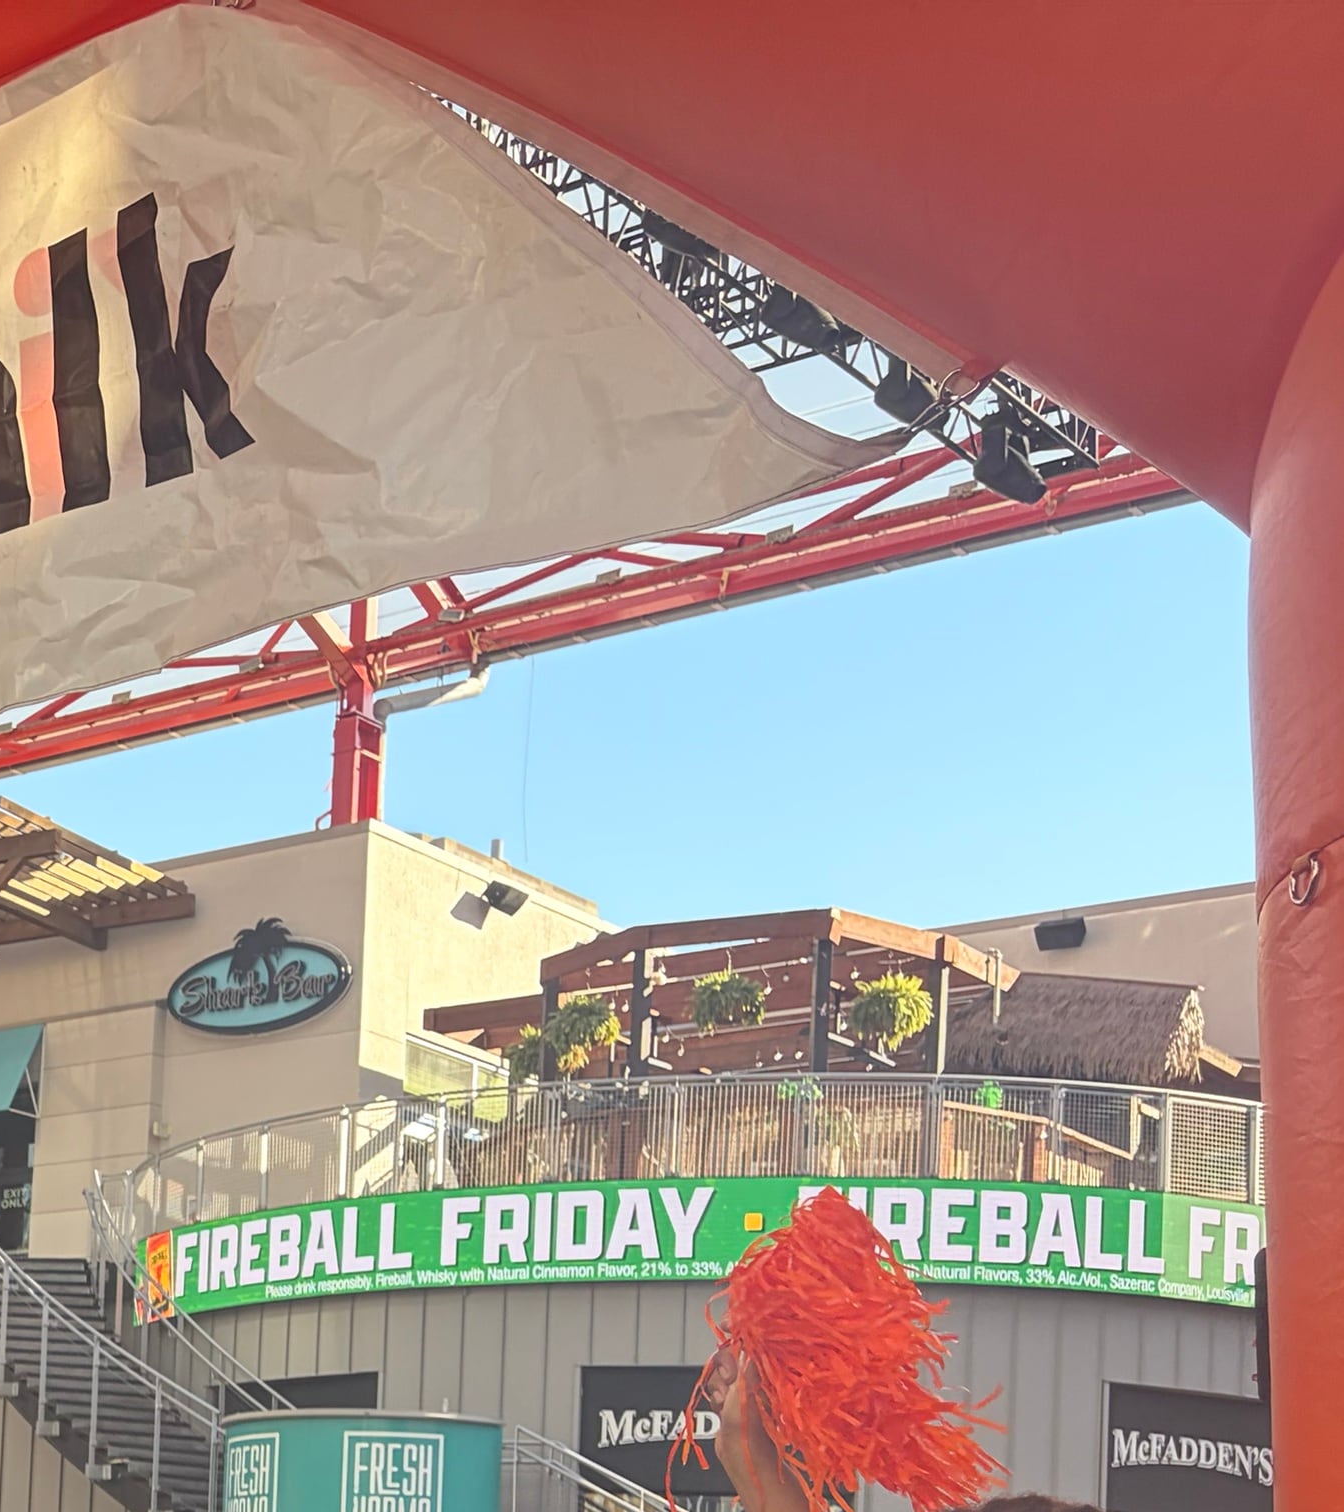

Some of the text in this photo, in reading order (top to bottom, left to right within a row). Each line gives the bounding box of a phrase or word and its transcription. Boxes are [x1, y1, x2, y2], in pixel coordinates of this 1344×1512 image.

[179, 959, 336, 1017] Shark Bar
[174, 1203, 413, 1298] FIREBALL
[440, 1187, 715, 1266] FRIDAY
[798, 1185, 1165, 1275] REBALL
[265, 1282, 293, 1299] Please
[294, 1279, 317, 1296] drink
[417, 1268, 456, 1285] Whisky
[460, 1267, 485, 1281] with
[487, 1264, 530, 1281] Natural
[532, 1264, 595, 1280] Cinnamon
[597, 1262, 639, 1279] Flavor,
[641, 1262, 671, 1277] 21%
[674, 1264, 689, 1277] to
[691, 1262, 723, 1277] 33%
[924, 1264, 971, 1280] Natural
[974, 1266, 1023, 1284] Flavors,
[1026, 1269, 1055, 1284] 33%
[1109, 1274, 1156, 1294] Sazerac
[228, 1444, 271, 1498] FRESH
[353, 1442, 433, 1497] FRESH
[1111, 1428, 1274, 1487] McFADDEN'S
